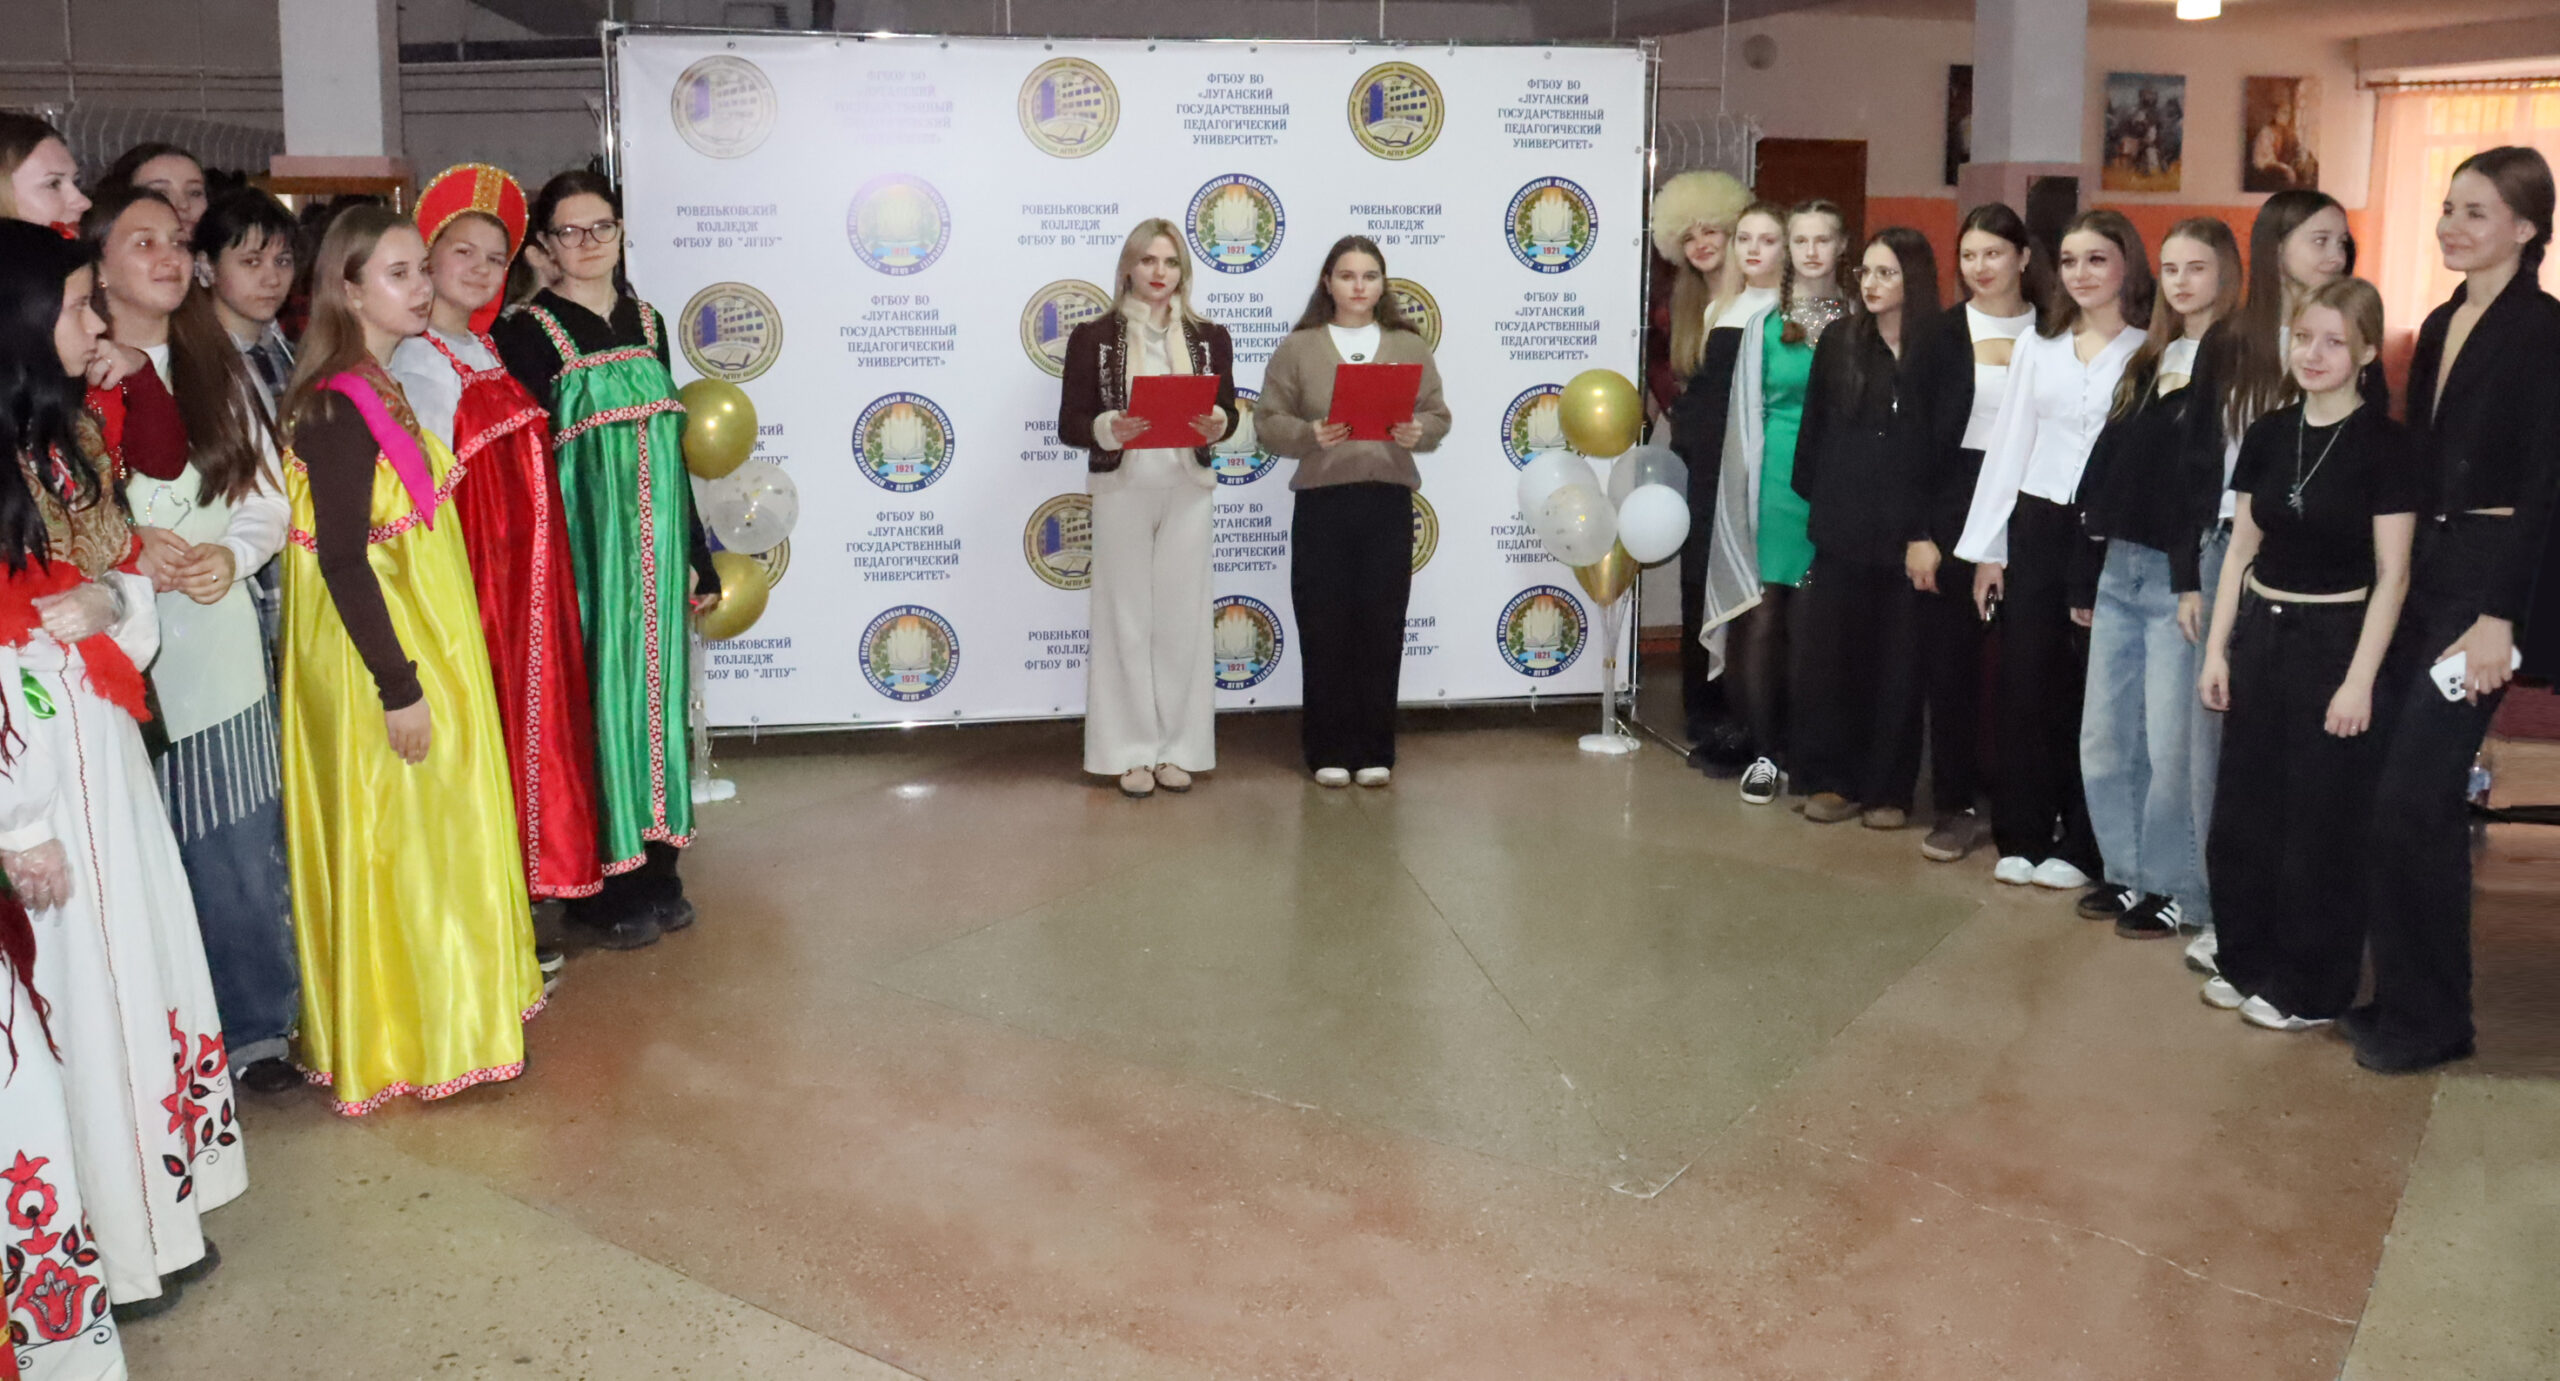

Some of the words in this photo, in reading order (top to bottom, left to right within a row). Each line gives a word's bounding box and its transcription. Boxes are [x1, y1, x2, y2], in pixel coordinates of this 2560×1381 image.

[1207, 73, 1245, 84] ФГБОУ
[1250, 74, 1264, 84] ВО
[1527, 78, 1563, 89] ФГБОУ
[1567, 80, 1581, 90] ВО
[1198, 88, 1273, 100] «ЛУГАНСКИЙ
[1518, 93, 1589, 105] «ЛУГАНСКИЙ
[1176, 103, 1290, 116] ГОСУДАРСТВЕННЫЙ
[1498, 108, 1604, 120] ГОСУДАРСТВЕННЫЙ
[1184, 118, 1287, 131] ПЕДАГОГИЧЕСКИЙ
[1505, 123, 1602, 135] ПЕДАГОГИЧЕСКИЙ
[1192, 134, 1279, 145] УНИВЕРСИТЕТ»
[1513, 138, 1593, 149] УНИВЕРСИТЕТ»
[676, 204, 777, 217] РОВЕНЬКОВСКИЙ
[1022, 203, 1119, 215] РОВЕНЬКОВСКИЙ
[1350, 204, 1442, 215] РОВЕНЬКОВСКИЙ
[696, 221, 759, 233] КОЛЛЕДЖ
[1041, 219, 1101, 231] КОЛЛЕДЖ
[1368, 220, 1424, 231] КОЛЛЕДЖ
[673, 237, 712, 248] ФГБОУ
[718, 237, 733, 248] ВО
[1017, 235, 1056, 246] ФГБОУ
[1061, 235, 1075, 245] ВО
[1387, 235, 1400, 245] ВО
[871, 295, 910, 306] ФГБОУ
[915, 295, 930, 305] ВО
[1208, 293, 1245, 303] ФГБОУ
[1250, 293, 1263, 303] ВО
[1524, 292, 1559, 302] ФГБОУ
[1563, 292, 1577, 302] ВО
[861, 309, 939, 321] «ЛУГАНСКИЙ
[1515, 305, 1585, 317] «ЛУГАНСКИЙ
[840, 324, 957, 338] ГОСУДАРСТВЕННЫЙ
[1495, 320, 1600, 332] ГОСУДАРСТВЕННЫЙ
[847, 339, 954, 354] ПЕДАГОГИЧЕСКИЙ
[1501, 334, 1598, 348] ПЕДАГОГИЧЕСКИЙ
[857, 356, 946, 367] УНИВЕРСИТЕТ»
[1509, 350, 1589, 361] УНИВЕРСИТЕТ»
[1021, 451, 1058, 461] ФГБОУ
[1064, 450, 1078, 460] ВО
[1249, 503, 1263, 513] ВО
[876, 511, 915, 522] ФГБОУ
[920, 510, 934, 521] ВО
[1213, 516, 1272, 528] УГАНСКИЙ
[867, 524, 944, 537] «ЛУГАНСКИЙ
[1214, 530, 1288, 543] АРСТВЕННЫЙ
[846, 538, 961, 553] ГОСУДАРСТВЕННЫЙ
[1214, 544, 1286, 558] ГОГИЧЕСКИЙ
[854, 553, 959, 568] ПЕДАГОГИЧЕСКИЙ
[864, 570, 951, 582] УНИВЕРСИТЕТ»
[702, 637, 792, 650] ОВЕНЬКОВСКИЙ
[1047, 644, 1089, 655] КОЛЛЕ
[714, 654, 774, 665] КОЛЛЕДЖ
[1025, 660, 1061, 670] ФГБОУ
[1067, 659, 1080, 669] ВО
[735, 669, 749, 679] ВО
